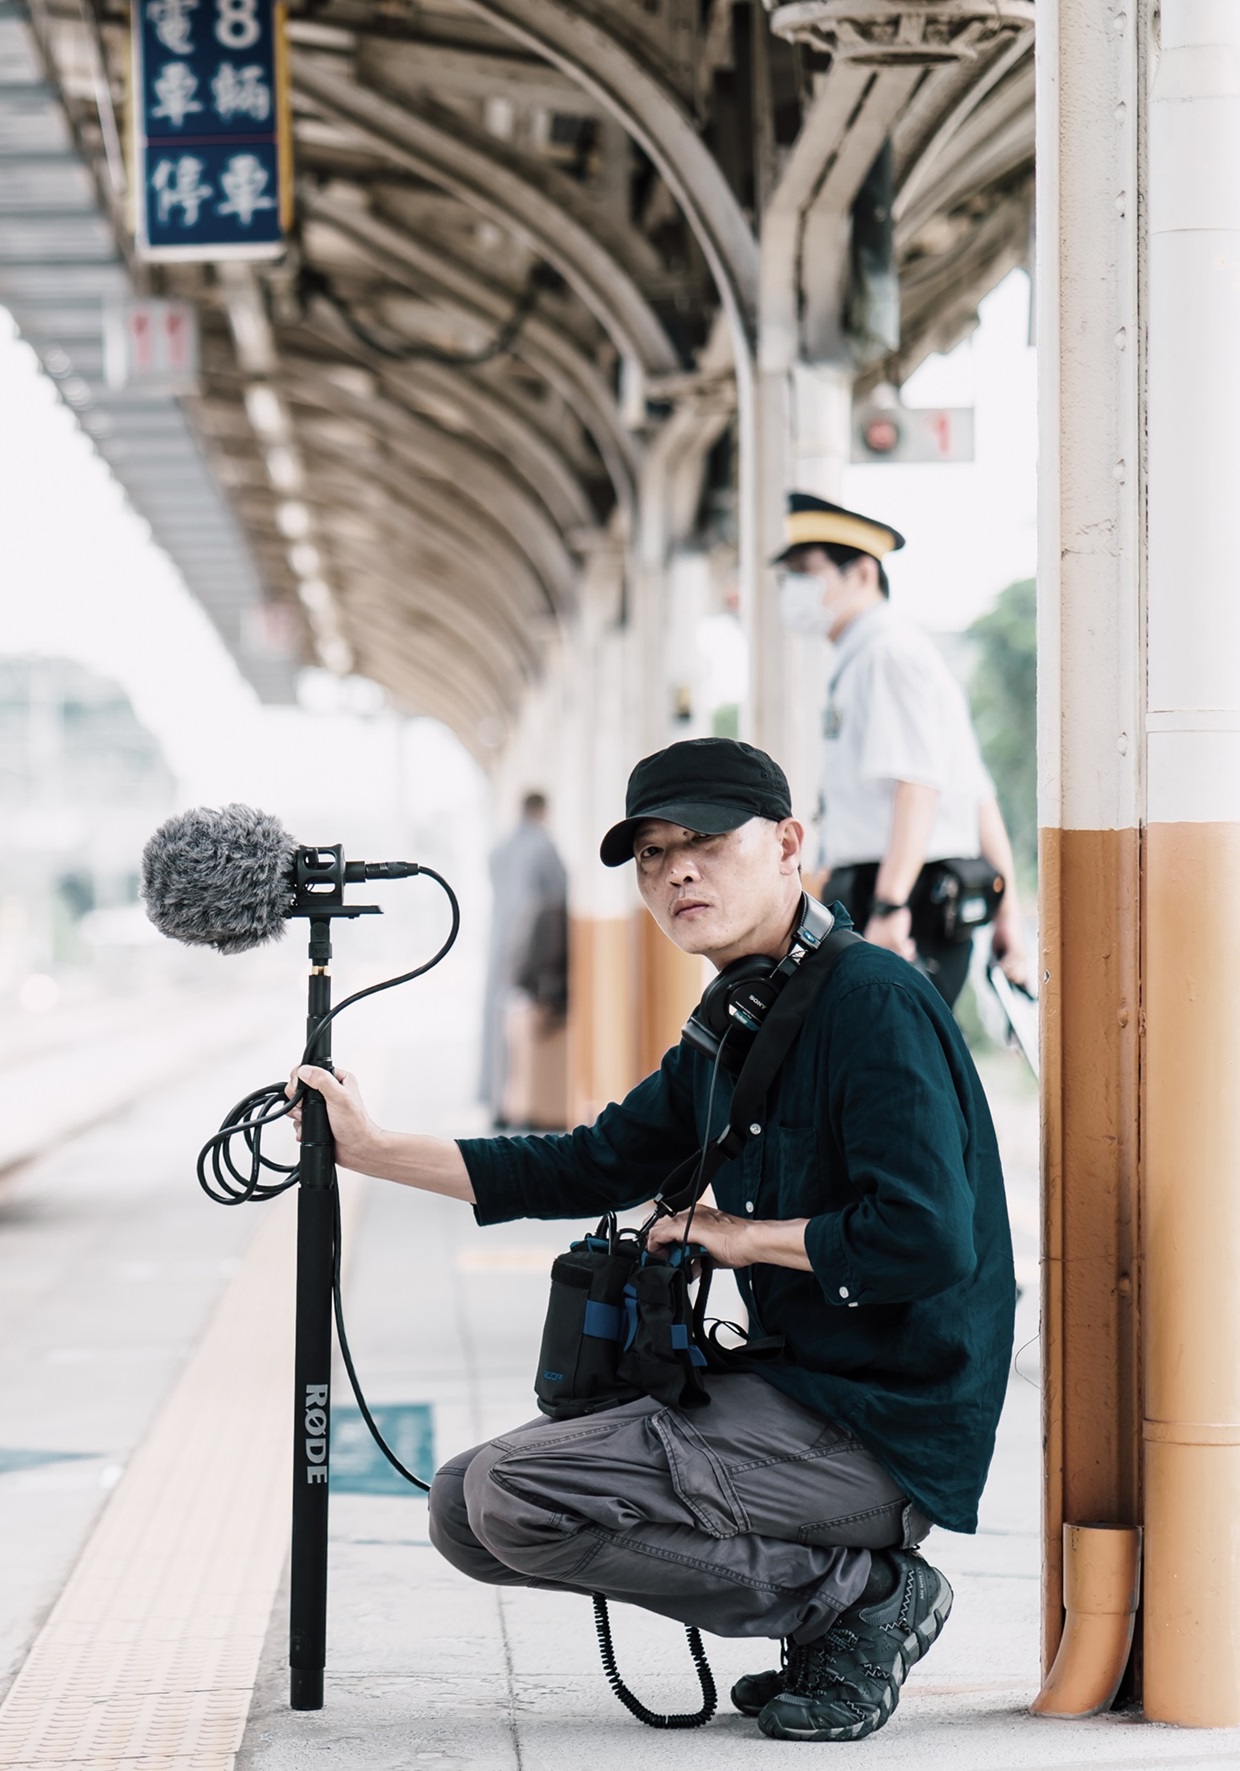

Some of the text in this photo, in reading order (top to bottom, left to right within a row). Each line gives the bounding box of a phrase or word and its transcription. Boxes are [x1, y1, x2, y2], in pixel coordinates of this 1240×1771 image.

[151, 153, 277, 226] 停車
[748, 994, 767, 1009] SONY
[304, 1383, 329, 1484] RØDE
